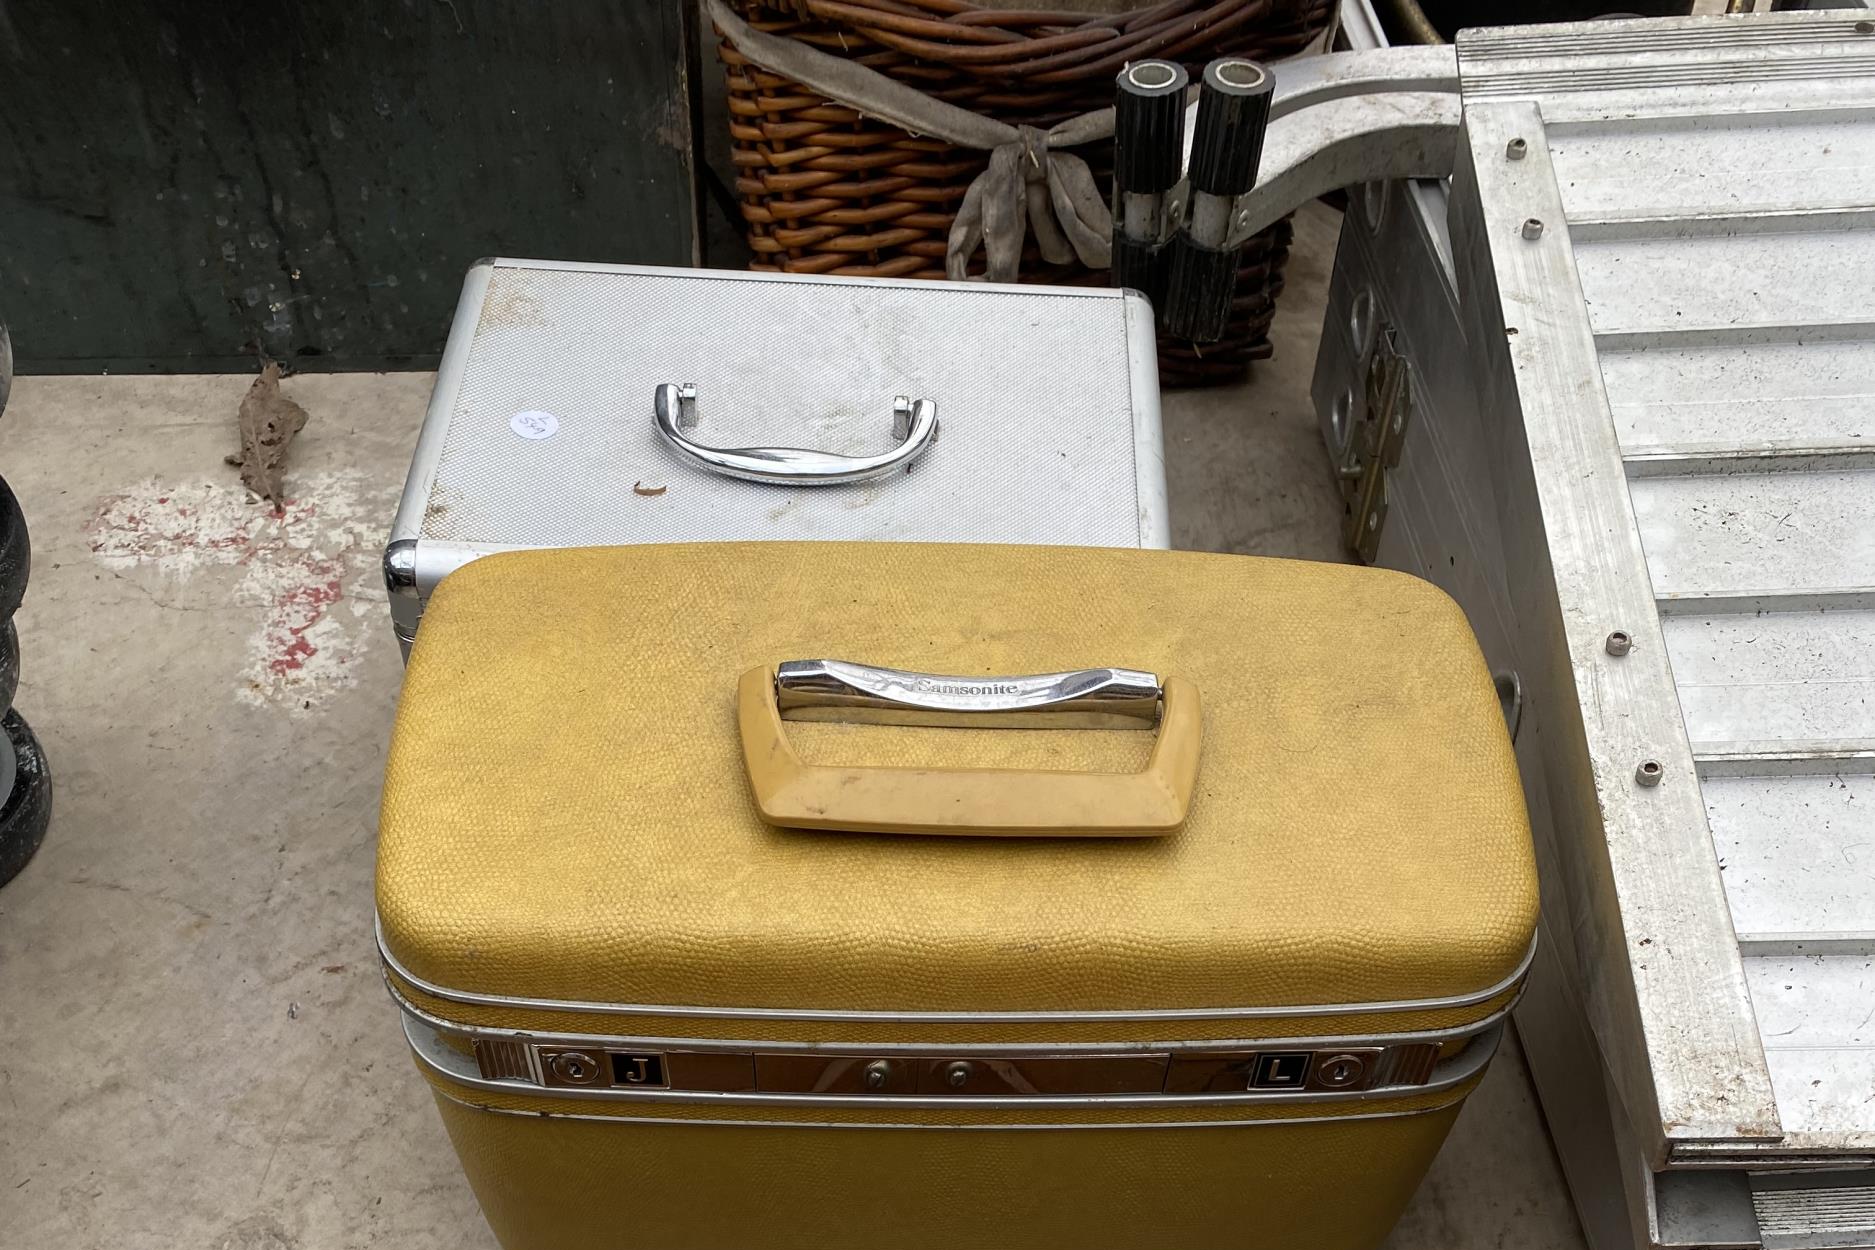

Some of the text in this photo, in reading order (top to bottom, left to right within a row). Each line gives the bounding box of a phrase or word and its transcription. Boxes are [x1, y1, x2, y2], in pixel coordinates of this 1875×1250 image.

[917, 681, 1019, 696] Samsonite
[626, 1058, 649, 1083] J
[1268, 1058, 1291, 1082] L
